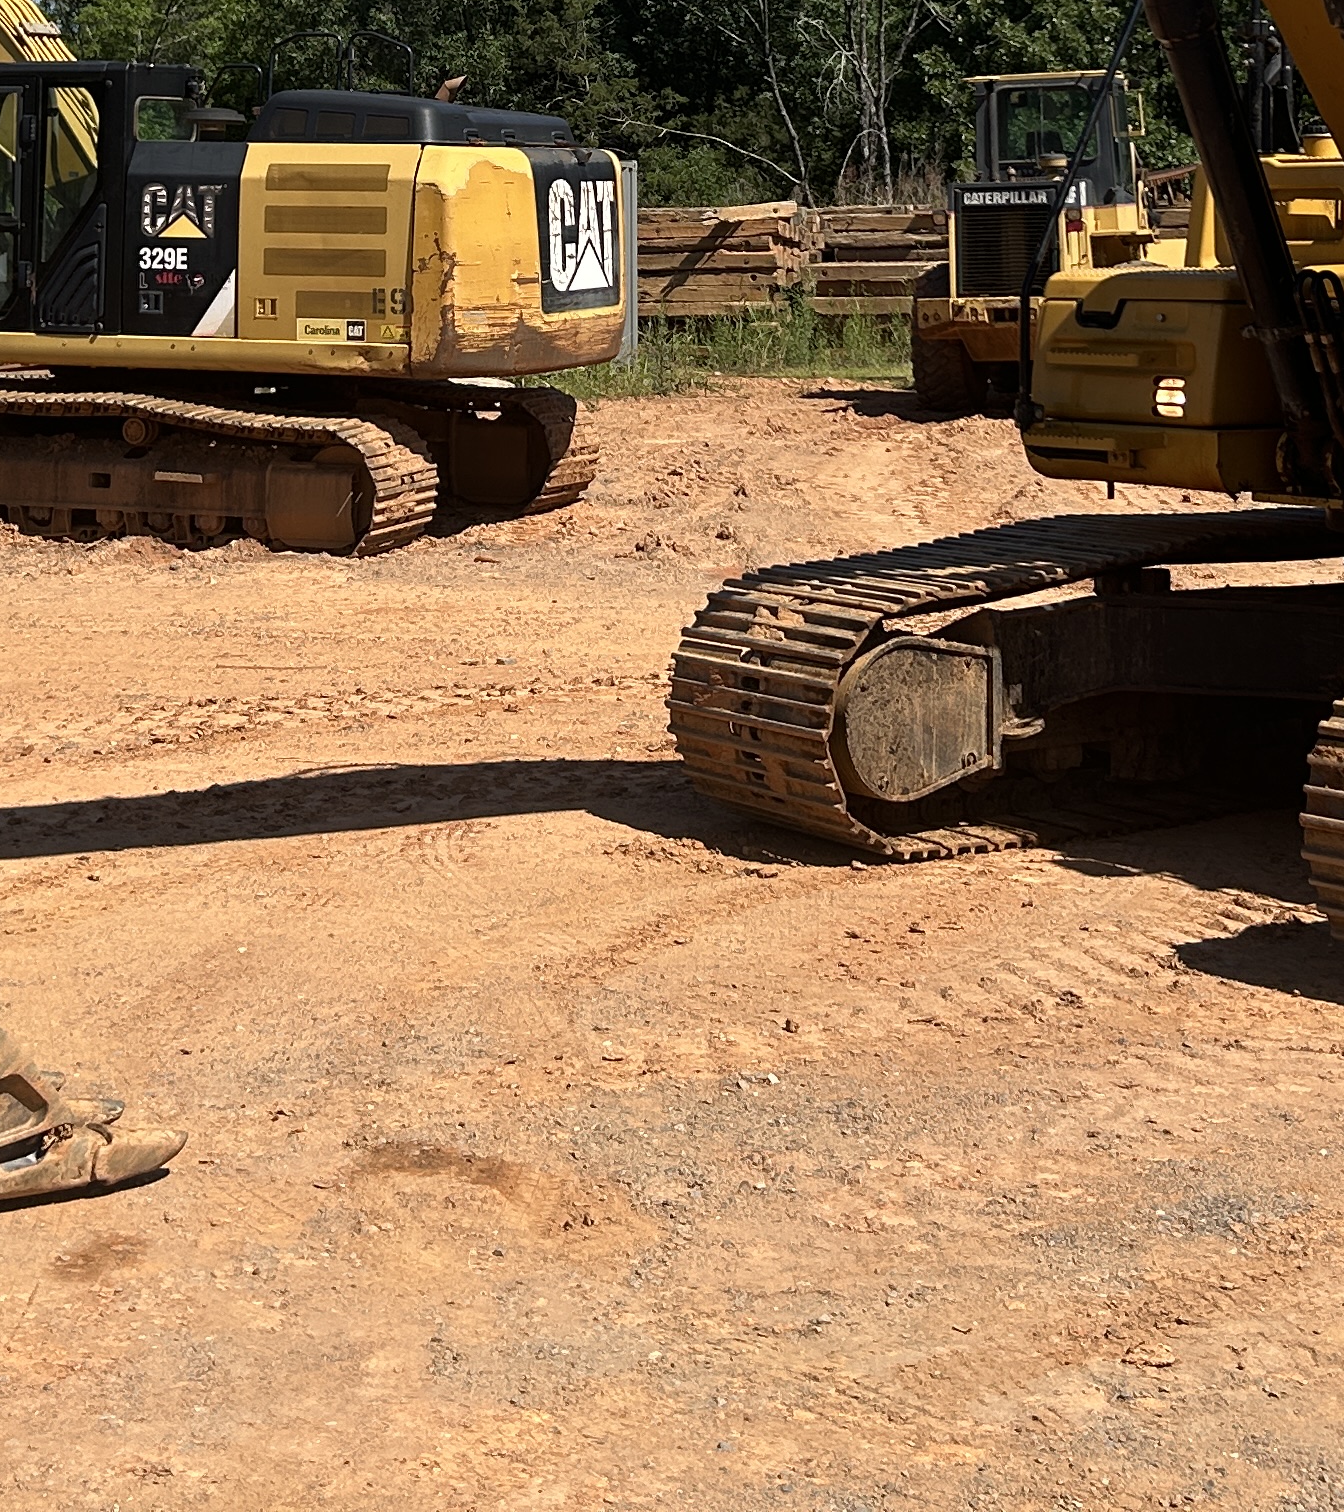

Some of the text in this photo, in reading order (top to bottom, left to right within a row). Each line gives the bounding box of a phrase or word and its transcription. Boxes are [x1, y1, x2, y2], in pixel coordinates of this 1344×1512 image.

[963, 191, 1047, 205] CATERPILLAR
[141, 182, 223, 238] CAT
[548, 178, 614, 291] CAT
[139, 247, 188, 270] 329E
[139, 272, 148, 288] L
[304, 324, 364, 337] Carolina CAT
